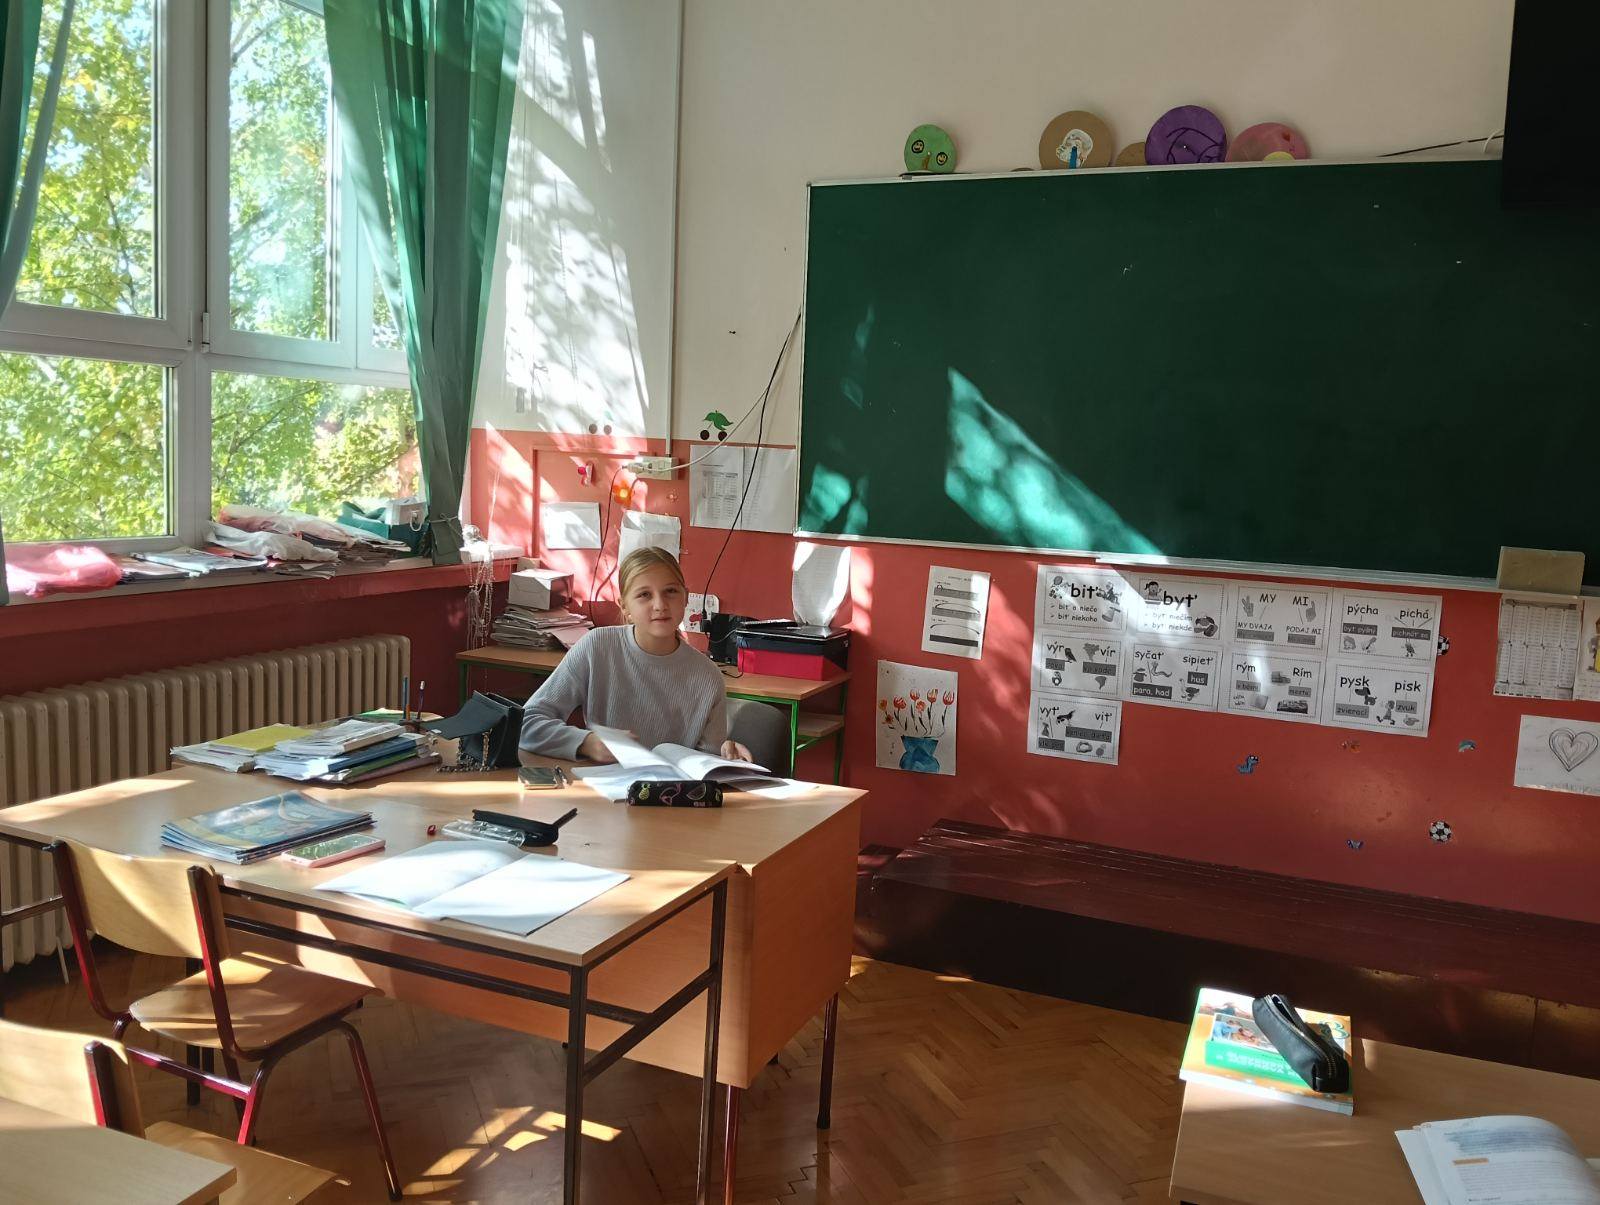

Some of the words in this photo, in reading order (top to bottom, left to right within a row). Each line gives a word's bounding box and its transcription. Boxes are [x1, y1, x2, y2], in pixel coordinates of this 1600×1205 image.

[1071, 583, 1099, 599] biť
[1163, 590, 1198, 610] byť
[1259, 593, 1277, 604] MY
[1292, 595, 1309, 606] MI
[1079, 605, 1098, 613] niečo
[1347, 602, 1379, 615] pýcha
[1399, 608, 1429, 619] pichá
[1286, 626, 1309, 634] PODAJ
[1046, 641, 1065, 654] výr
[1100, 646, 1116, 657] vír
[1135, 650, 1164, 661] syčať
[1182, 654, 1214, 666] sipieť
[1236, 661, 1256, 673] rým
[1292, 667, 1312, 679] Rím
[1190, 674, 1205, 684] hus
[1340, 675, 1370, 689] pysk
[1155, 687, 1170, 697] had
[1394, 680, 1421, 693] pisk
[1040, 706, 1060, 717] vyť
[1396, 704, 1416, 713] zvuk
[1095, 711, 1113, 722] viť
